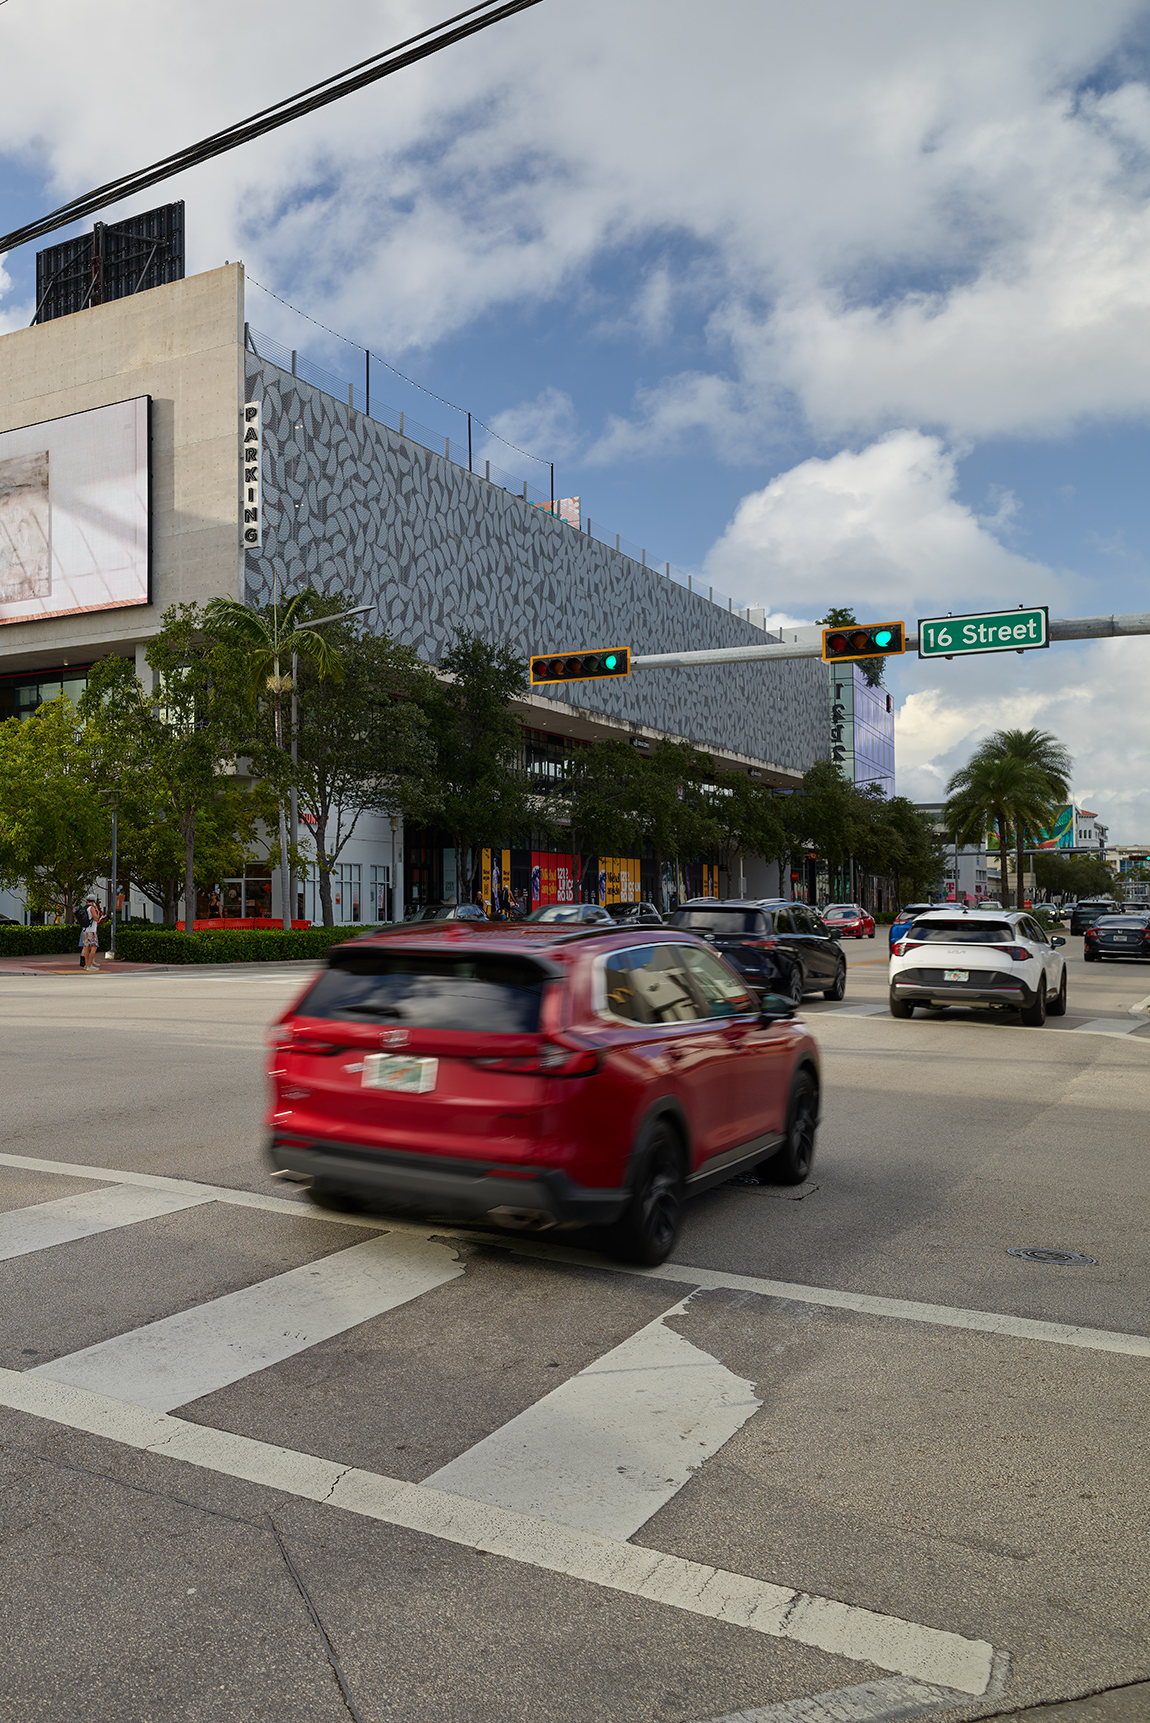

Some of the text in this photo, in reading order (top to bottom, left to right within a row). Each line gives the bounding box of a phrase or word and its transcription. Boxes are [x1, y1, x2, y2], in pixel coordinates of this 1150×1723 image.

[244, 407, 258, 543] PARKING
[927, 618, 1037, 648] 16 Street
[946, 882, 955, 893] T
